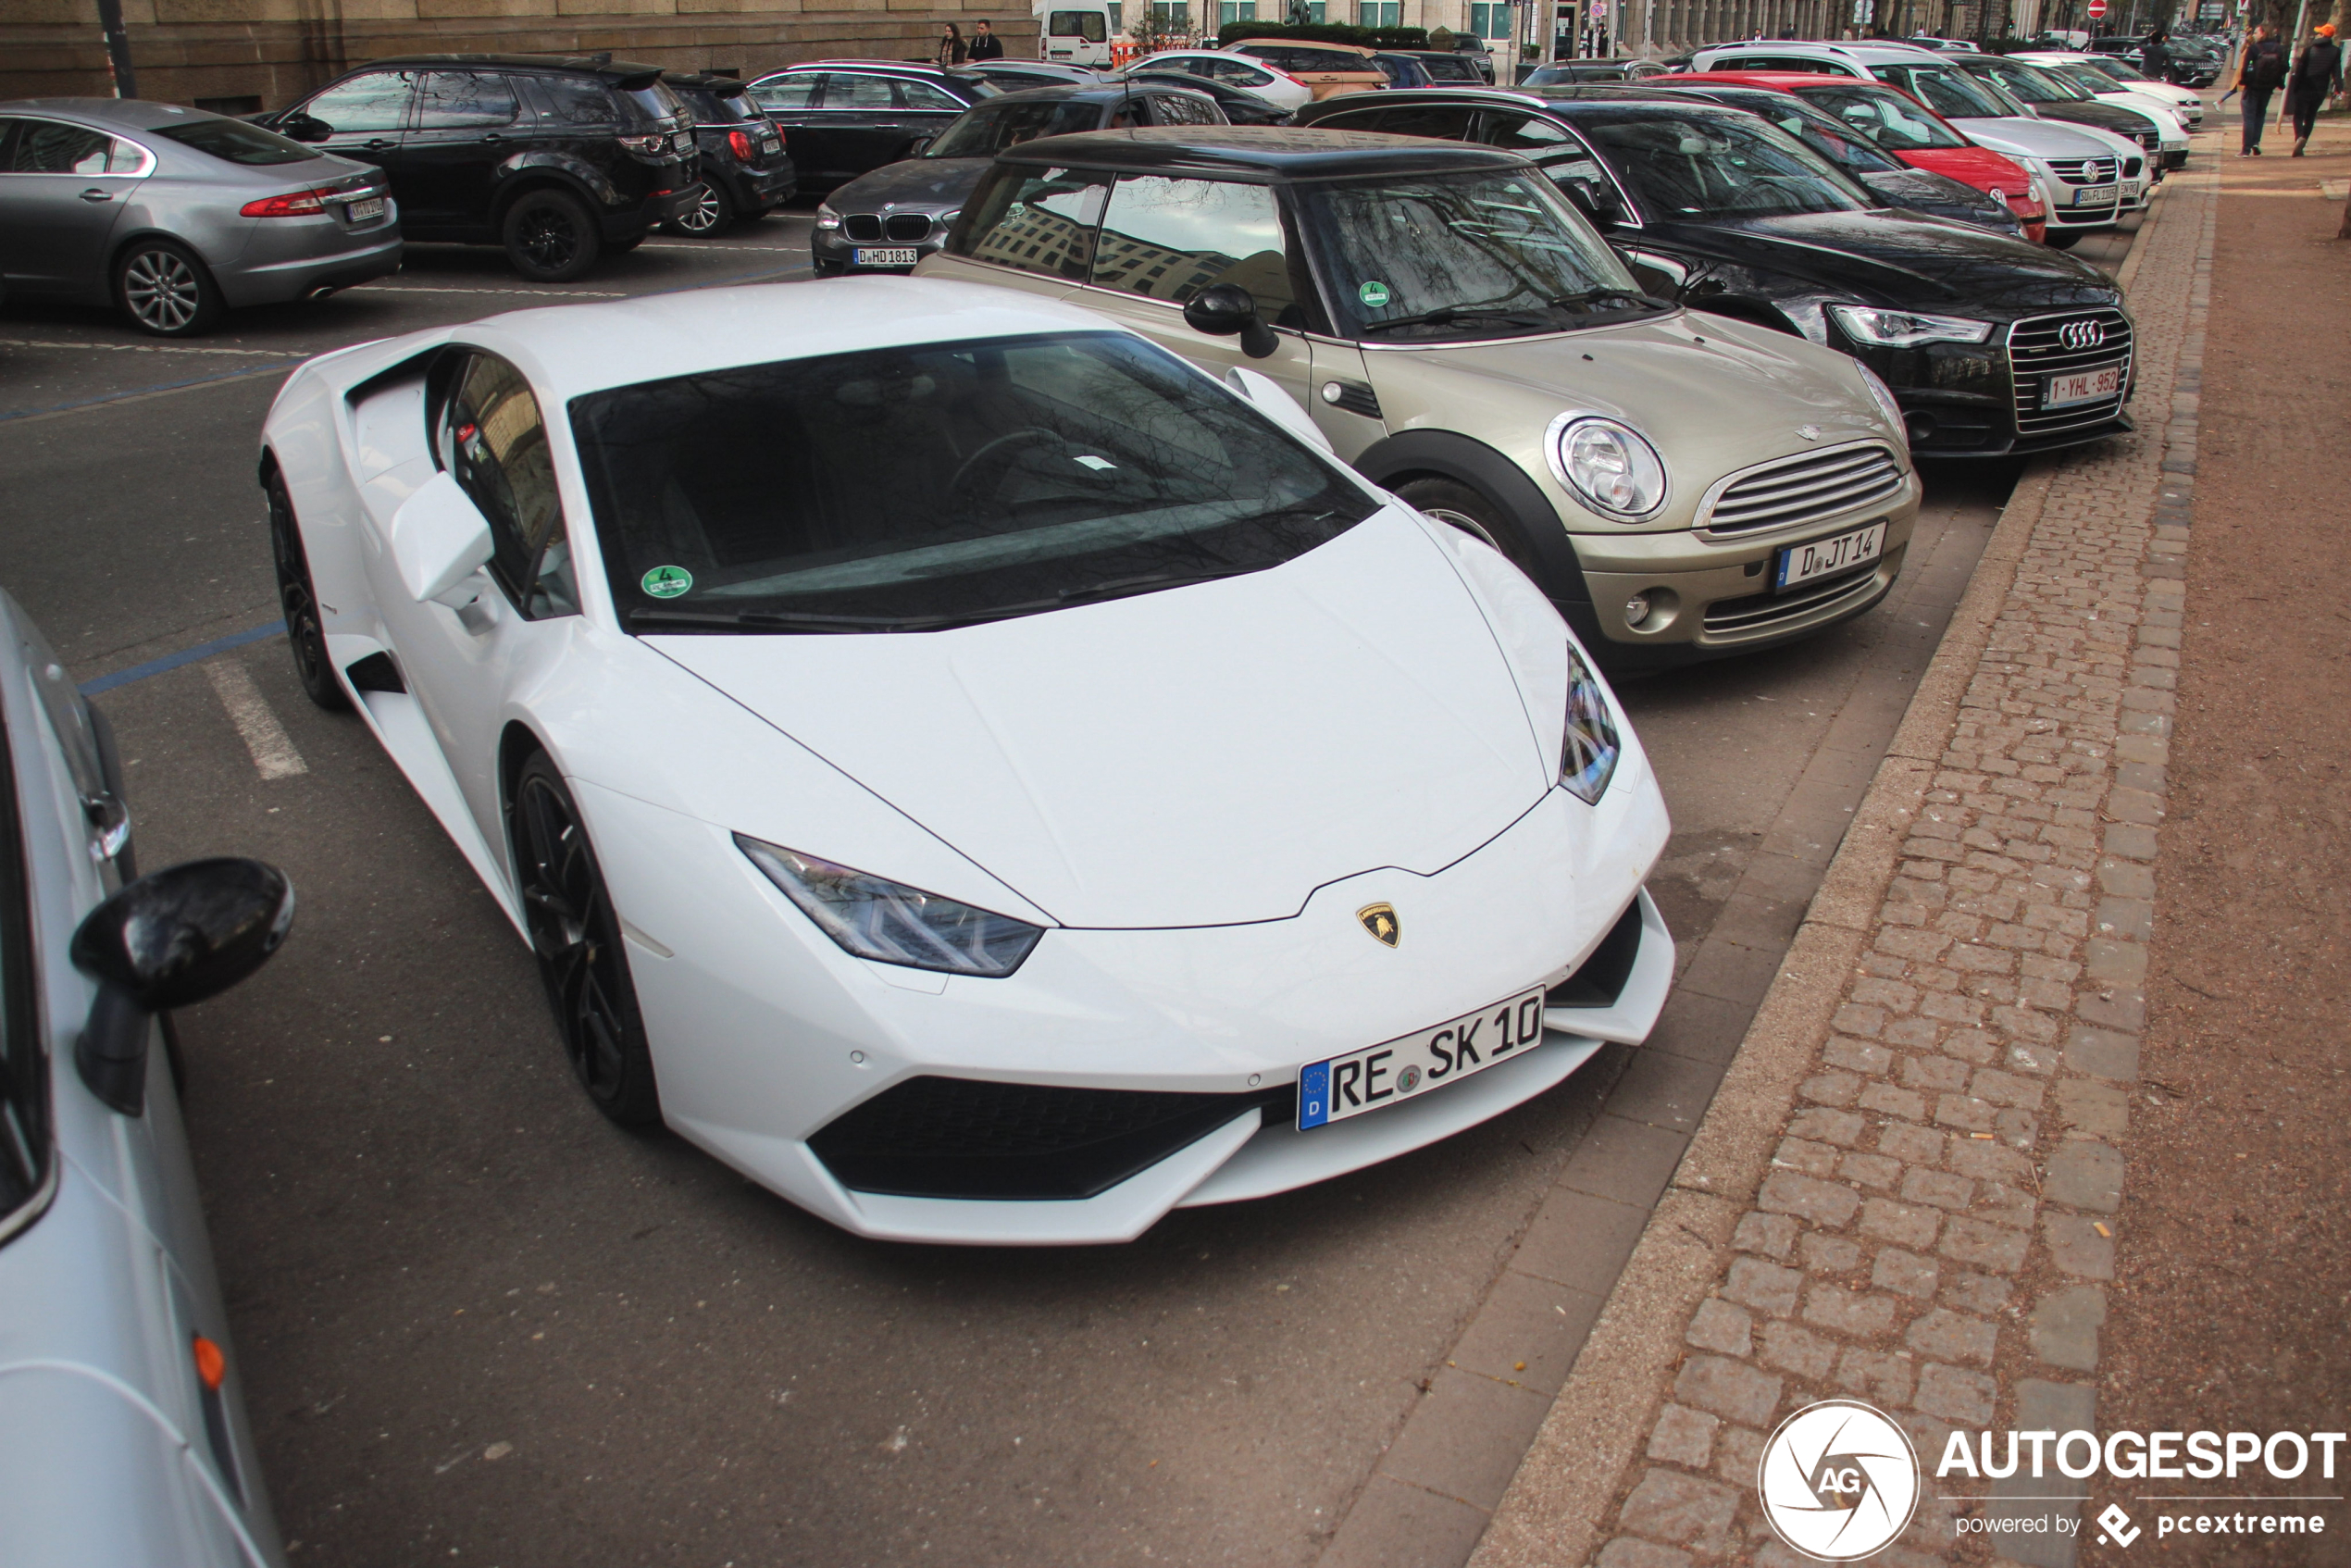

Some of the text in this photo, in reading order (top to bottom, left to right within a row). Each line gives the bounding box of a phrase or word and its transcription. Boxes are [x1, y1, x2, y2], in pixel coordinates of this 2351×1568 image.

[2081, 190, 2089, 201] SU
[2092, 189, 2100, 200] FL
[859, 250, 915, 263] D HD 1813
[1370, 282, 1378, 294] 4
[2042, 392, 2048, 402] B
[1800, 529, 1874, 577] D JT 14
[659, 567, 673, 581] 4
[1779, 572, 1785, 581] D
[1332, 995, 1541, 1114] RE SK 10
[1309, 1101, 1320, 1116] D
